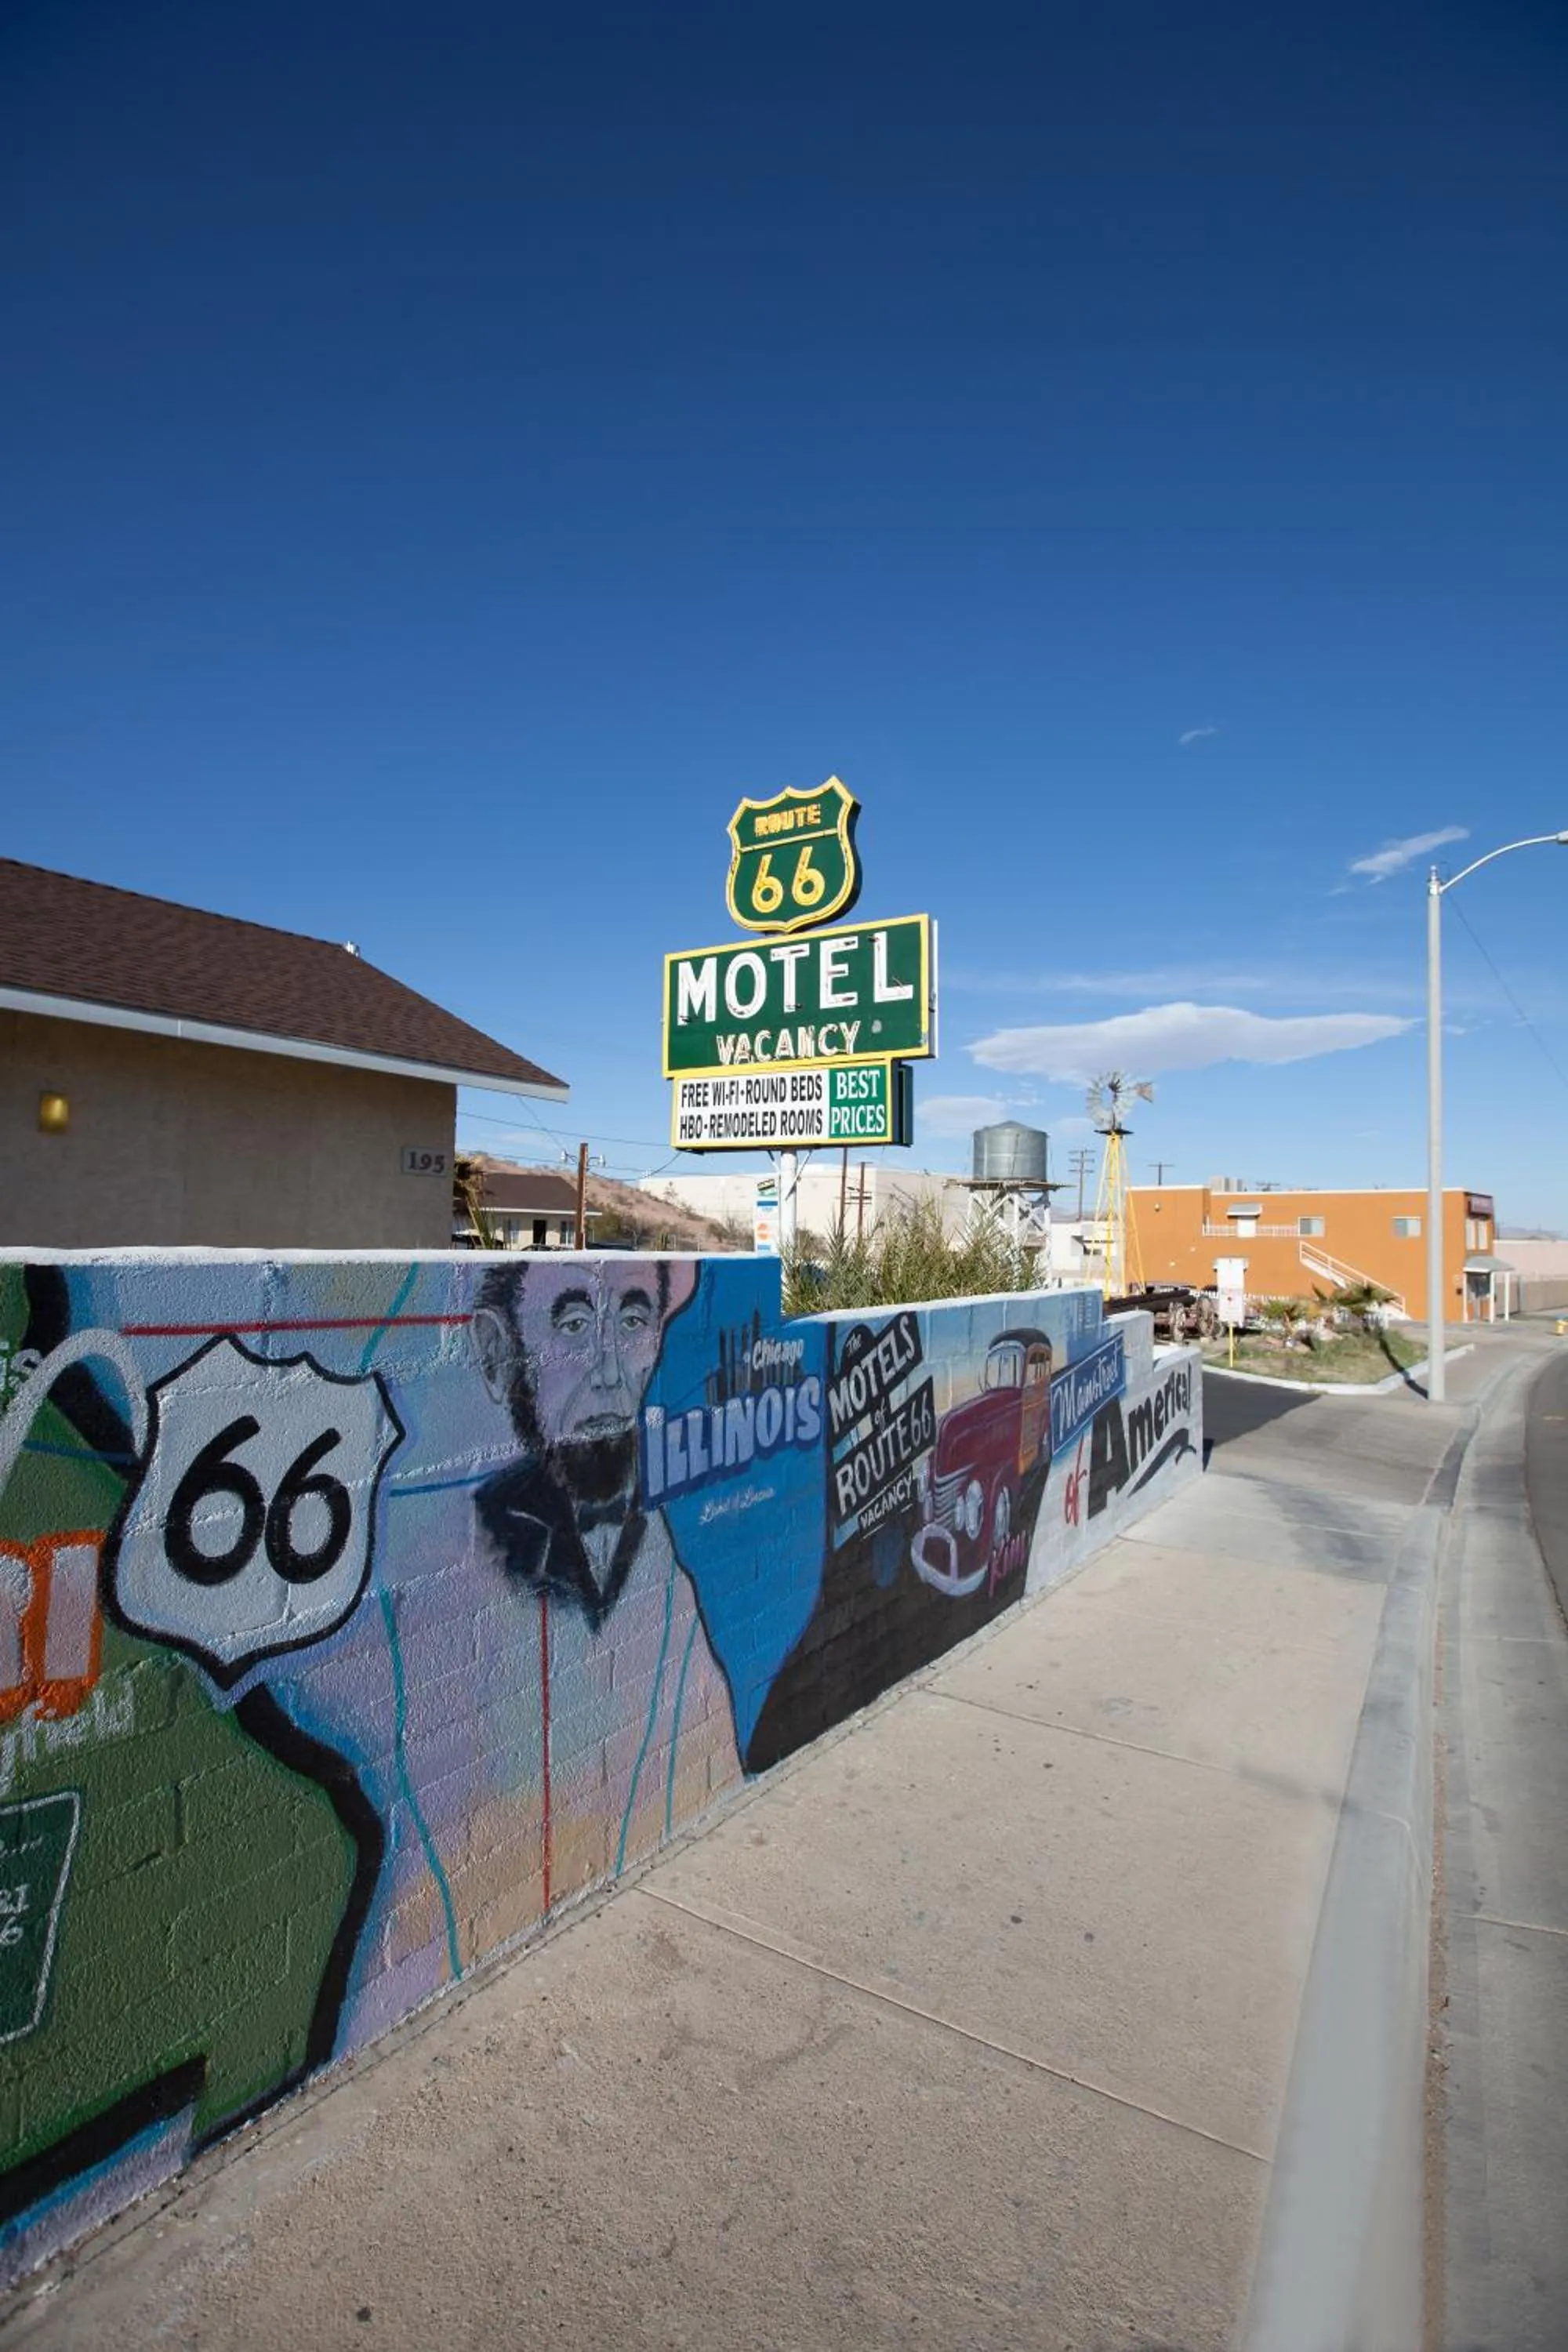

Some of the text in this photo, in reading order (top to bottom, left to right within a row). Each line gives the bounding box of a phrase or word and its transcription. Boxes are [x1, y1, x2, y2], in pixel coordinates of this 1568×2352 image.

[754, 803, 822, 837] ROUTE
[751, 846, 826, 913] 66
[677, 931, 914, 1026] MOTEL
[716, 1020, 862, 1065] VACANCY
[681, 1083, 709, 1108] FREE
[791, 1074, 822, 1102] BEDS
[835, 1069, 880, 1099] BEST
[780, 1108, 822, 1136] ROOMS
[831, 1104, 885, 1134] PRICES
[408, 1150, 445, 1174] 195
[753, 1338, 804, 1371] Chicago
[828, 1315, 915, 1434] MOTELS
[874, 1397, 887, 1433] of
[645, 1375, 821, 1498] ILLINOIS
[836, 1389, 931, 1517] ROUTE 66
[164, 1414, 352, 1587] 66
[860, 1470, 913, 1529] VACANCY
